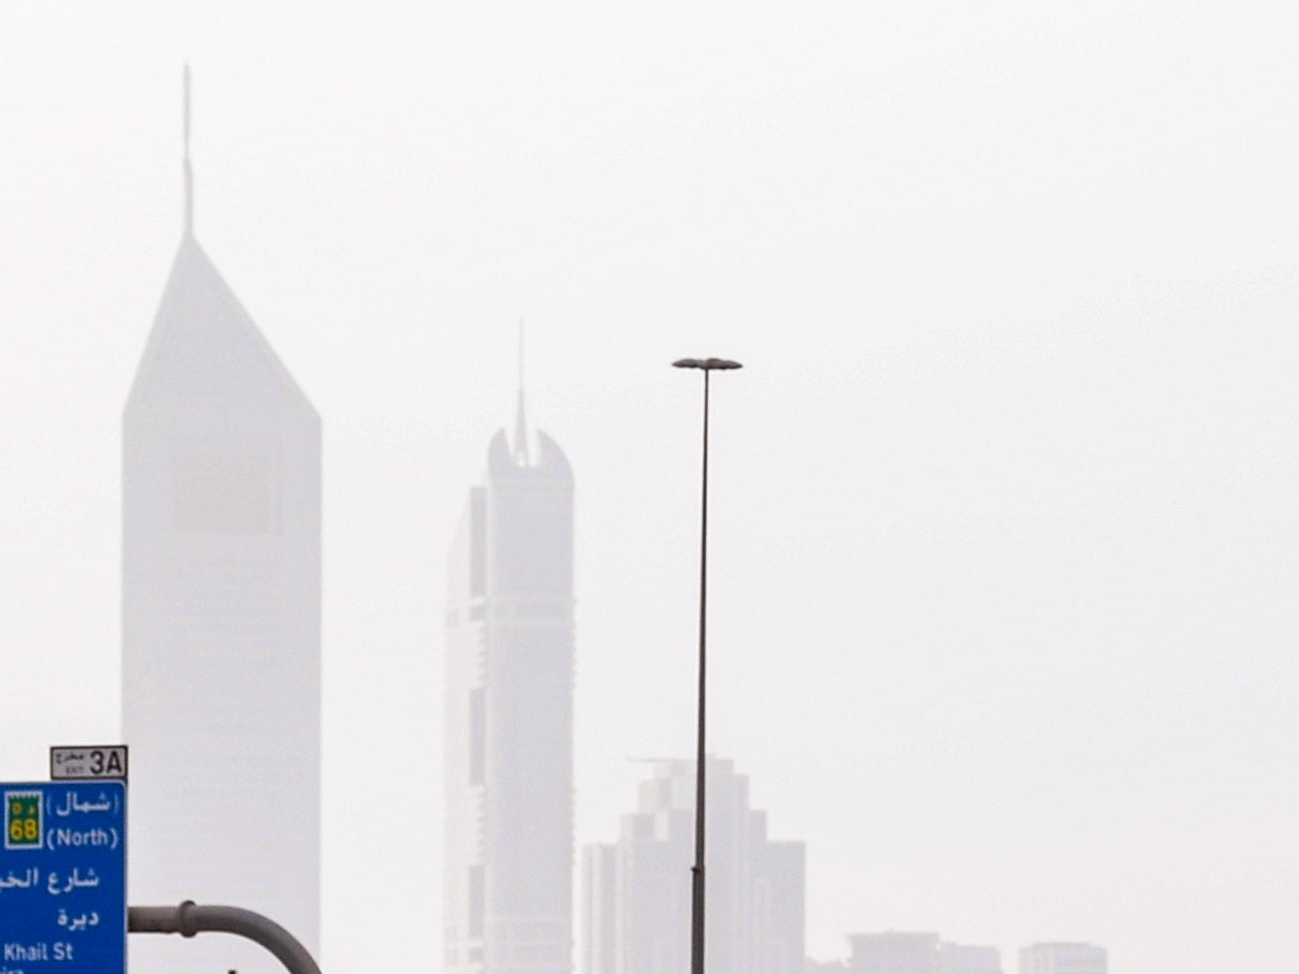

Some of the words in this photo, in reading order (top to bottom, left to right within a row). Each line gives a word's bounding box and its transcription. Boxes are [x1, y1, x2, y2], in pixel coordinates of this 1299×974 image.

[90, 750, 122, 774] 3A
[46, 791, 119, 816] (شمال)
[10, 818, 37, 840] 68
[47, 827, 119, 850] (North)
[47, 867, 99, 894] شارع
[57, 908, 99, 931] ديرة
[4, 943, 48, 961] Khail
[53, 942, 73, 960] St
